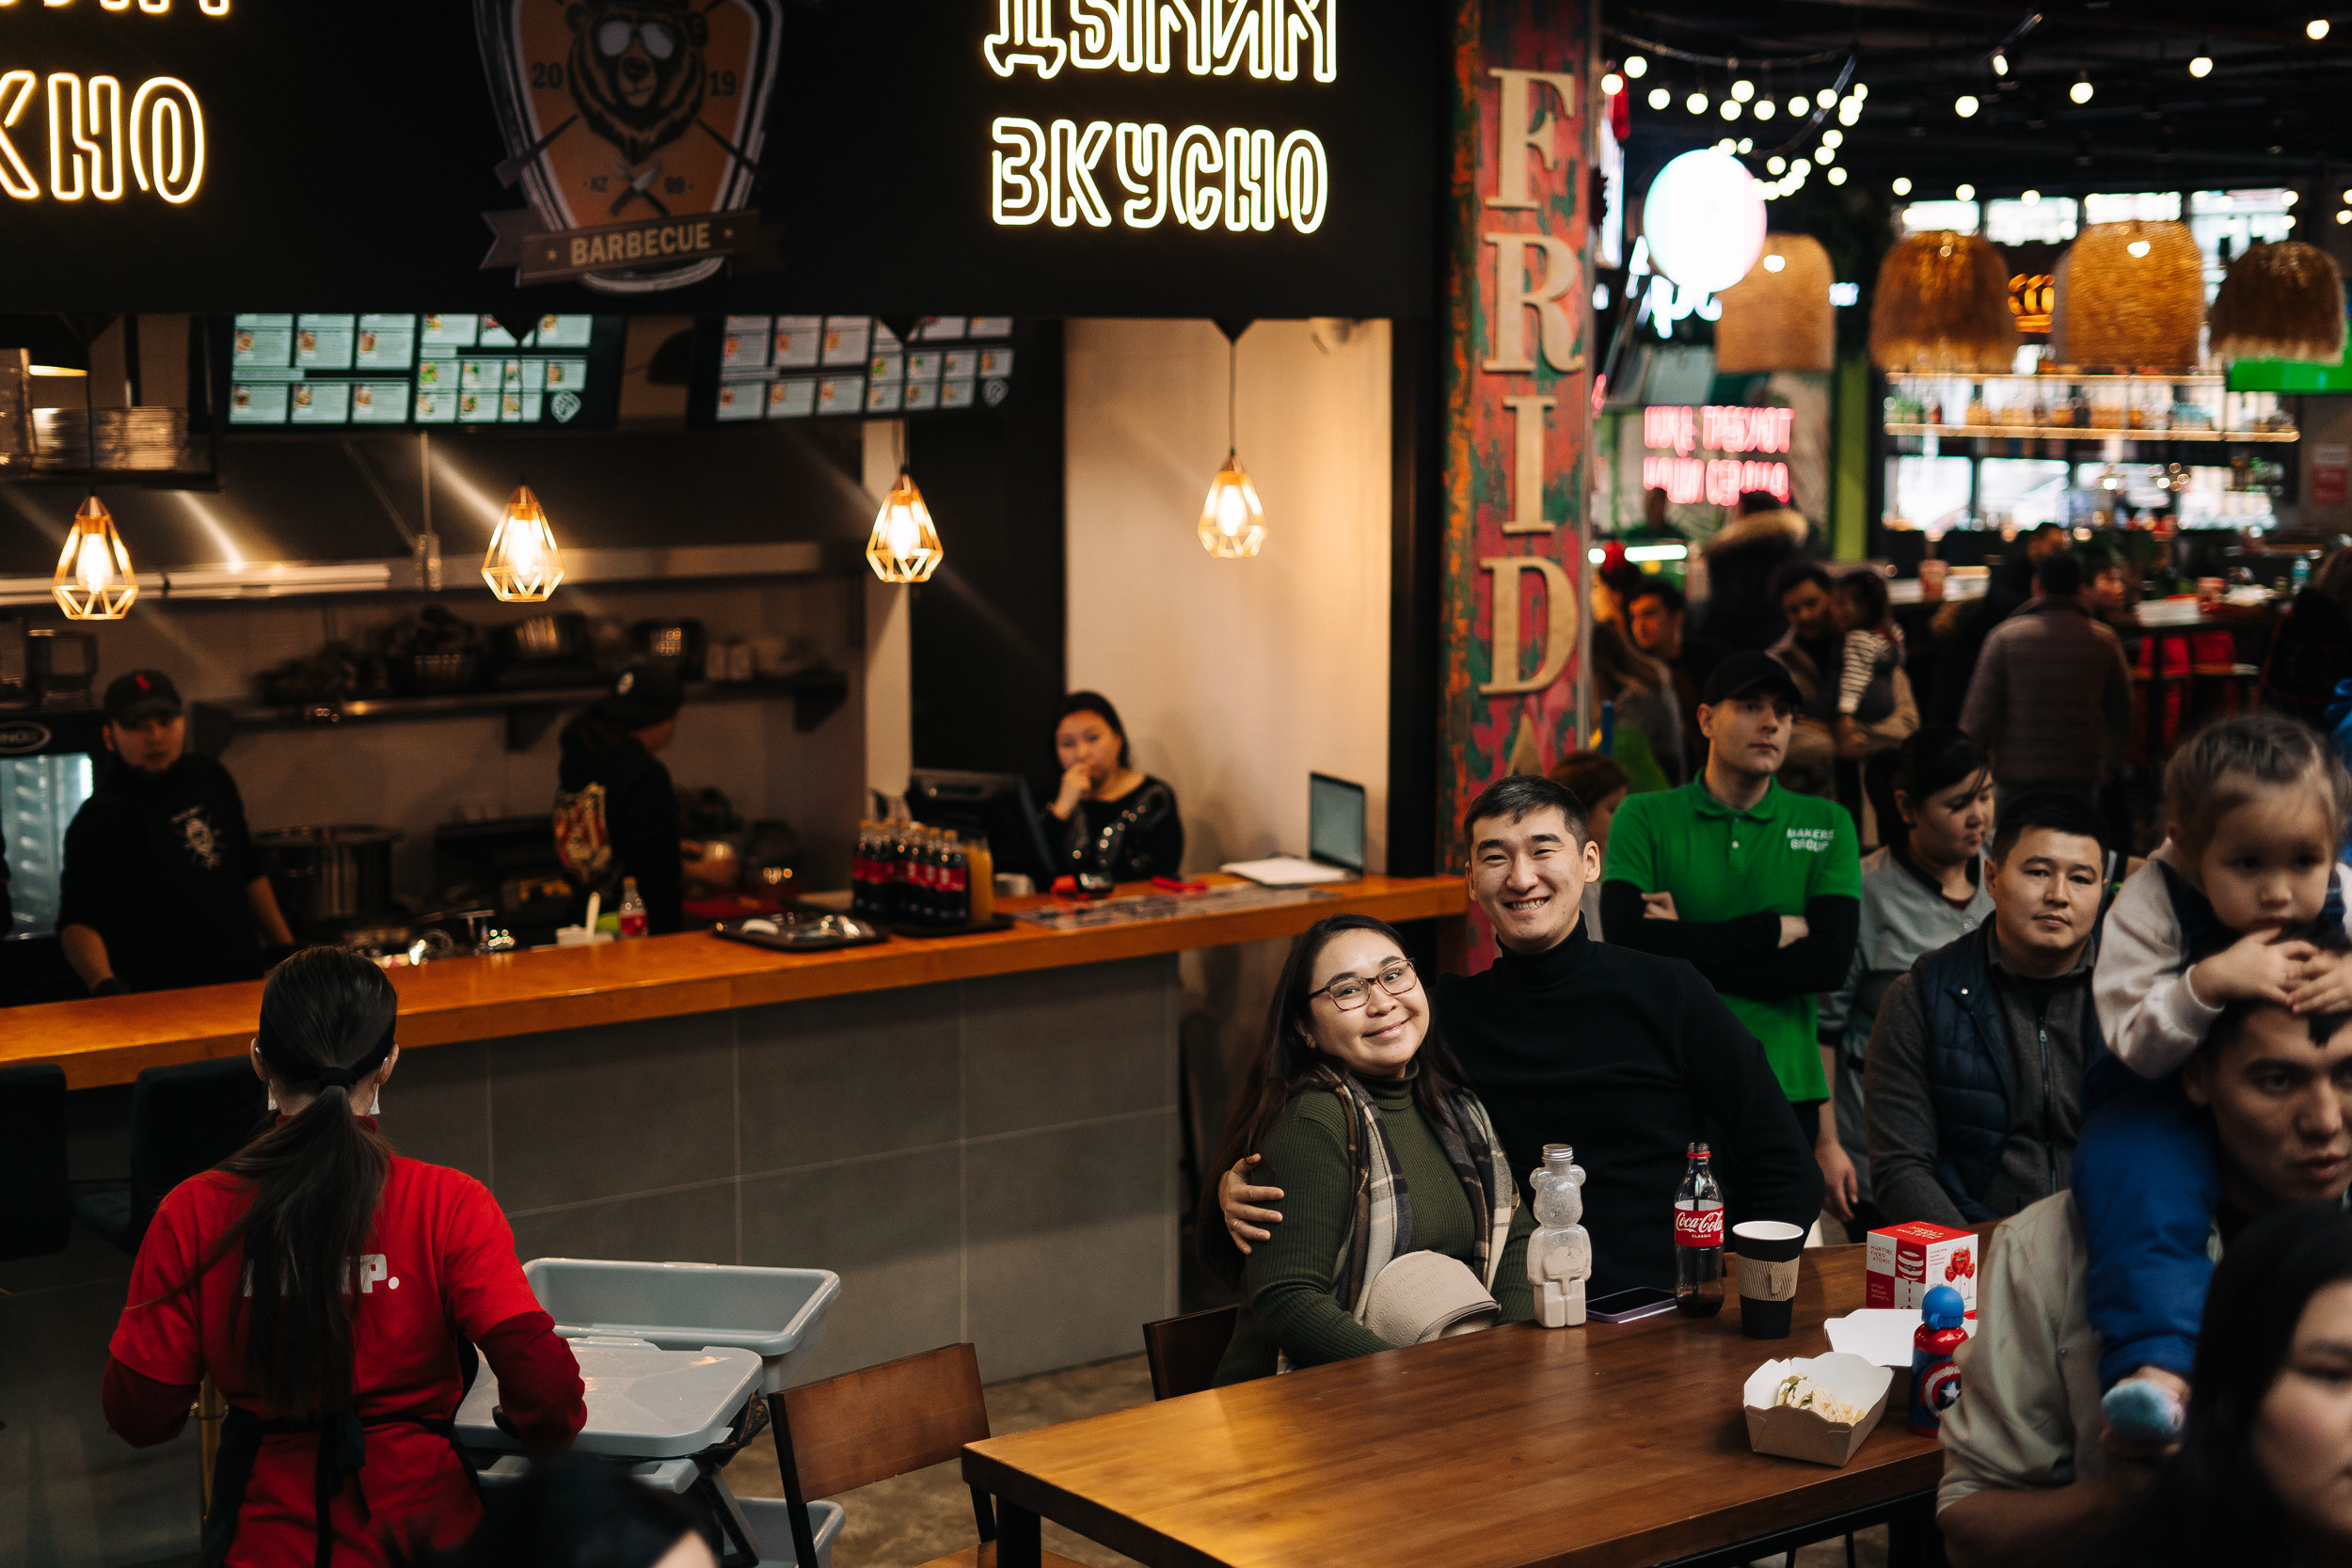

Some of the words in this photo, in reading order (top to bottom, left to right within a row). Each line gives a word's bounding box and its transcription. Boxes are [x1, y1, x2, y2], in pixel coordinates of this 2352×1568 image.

[532, 61, 564, 91] 20
[708, 70, 738, 99] 19
[991, 116, 1328, 235] ВКУСНО
[569, 221, 711, 267] BARBECUE
[1787, 828, 1834, 840] MAKERS
[1790, 838, 1829, 852] GROUP
[1677, 1211, 1724, 1233] Coca-Cola
[1870, 1245, 1893, 1254] MARTINI
